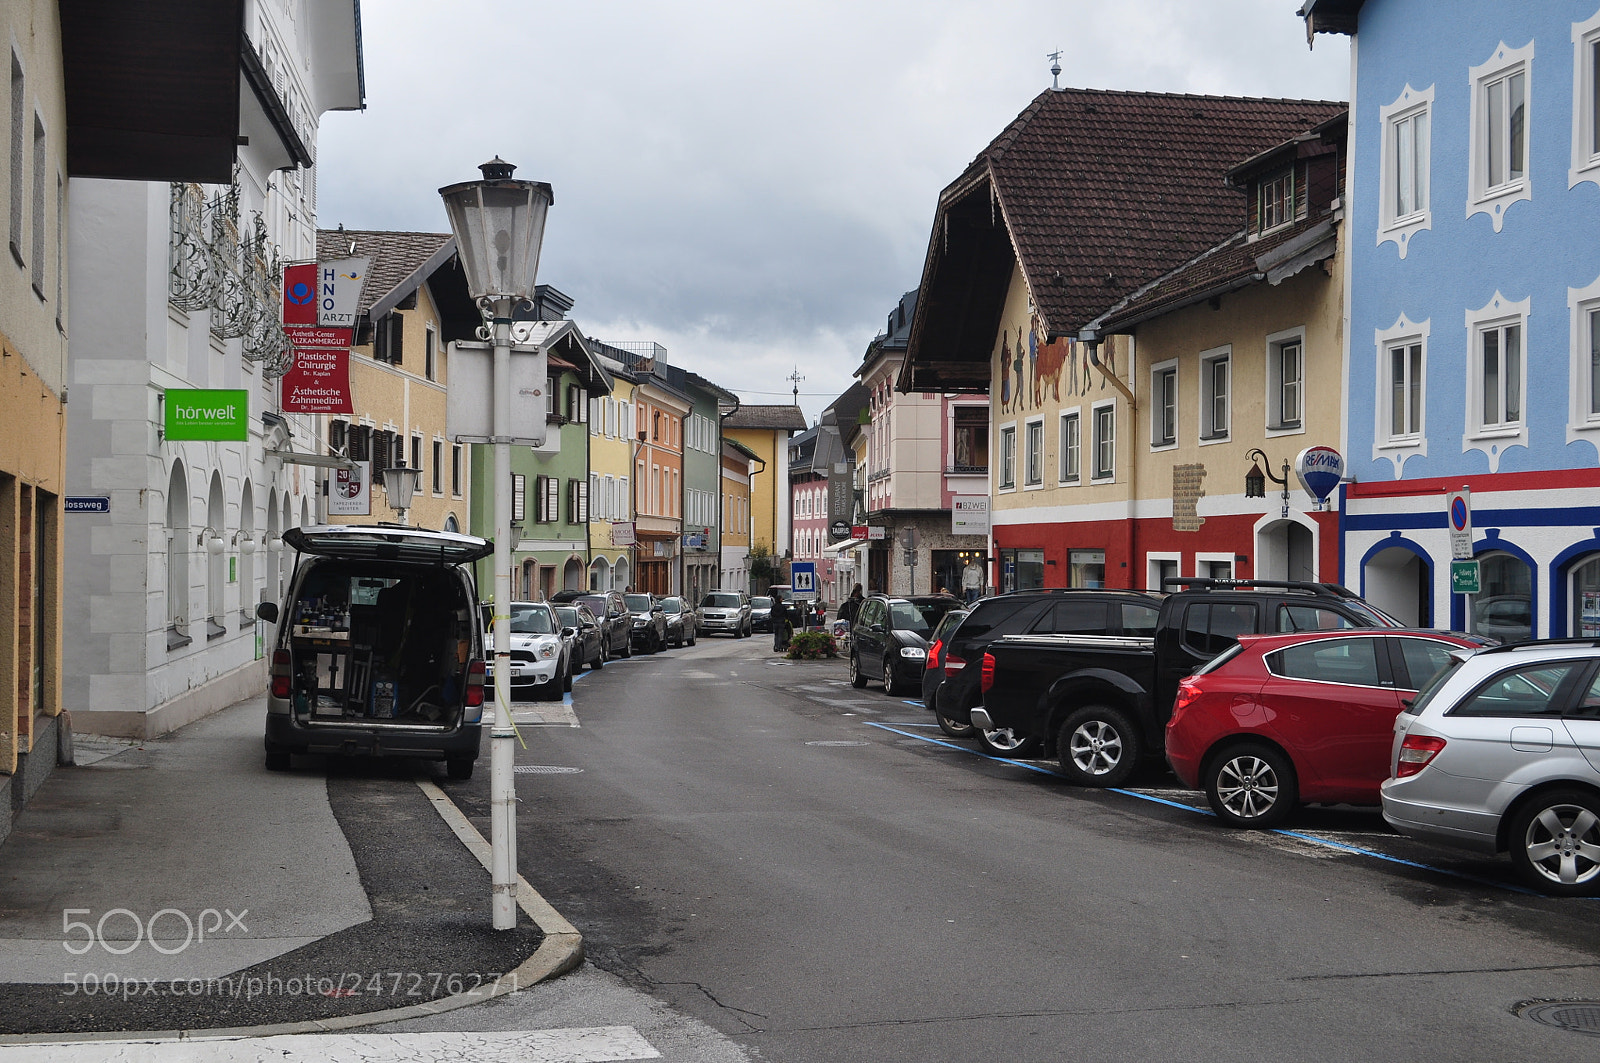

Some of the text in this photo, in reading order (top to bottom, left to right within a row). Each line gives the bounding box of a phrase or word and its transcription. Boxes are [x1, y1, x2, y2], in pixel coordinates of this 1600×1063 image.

[322, 313, 353, 322] ARZT
[297, 352, 337, 361] Plastische
[297, 361, 336, 371] Chirurgie
[293, 386, 341, 396] Ästhetische
[290, 396, 343, 405] Zahnmedizin
[175, 404, 236, 420] hörwelt
[1305, 453, 1340, 470] RE/MAX
[64, 500, 102, 511] lossweg
